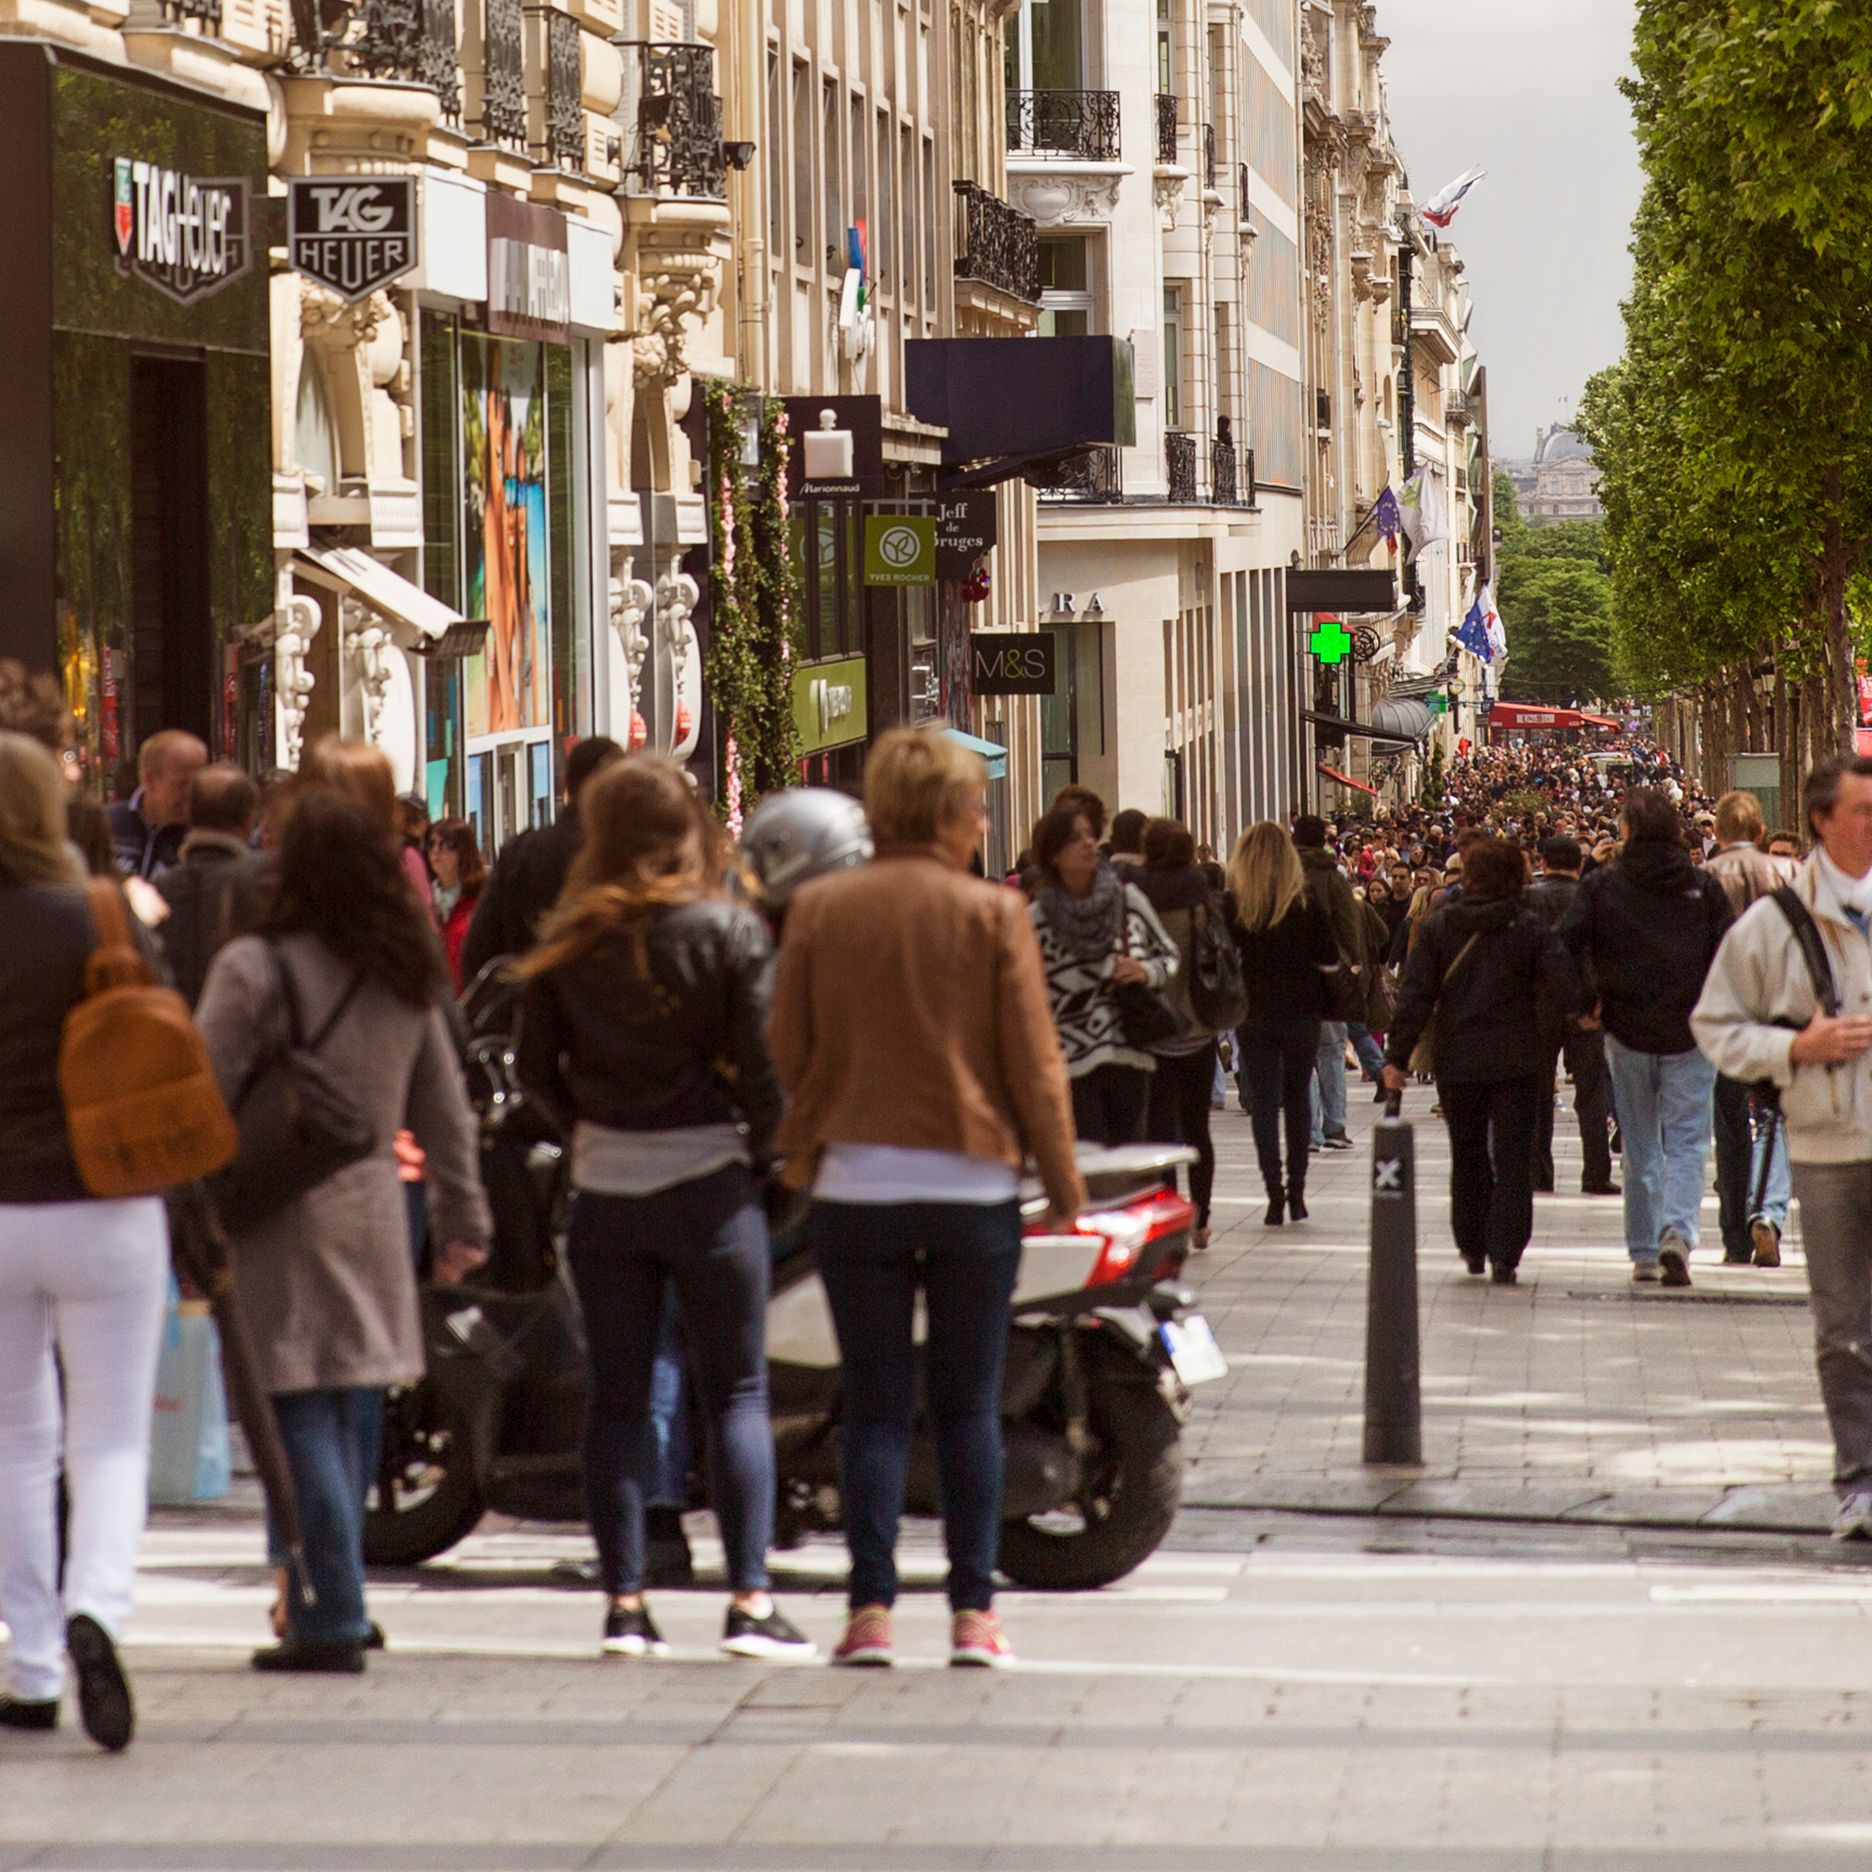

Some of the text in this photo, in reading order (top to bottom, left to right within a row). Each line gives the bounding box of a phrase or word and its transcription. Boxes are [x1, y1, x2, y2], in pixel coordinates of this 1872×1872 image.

[309, 184, 394, 232] TAG
[300, 240, 404, 289] HEUER
[799, 482, 861, 496] Marionnaud
[936, 502, 968, 522] Jeff
[945, 522, 959, 533] de
[976, 648, 1046, 679] M&S
